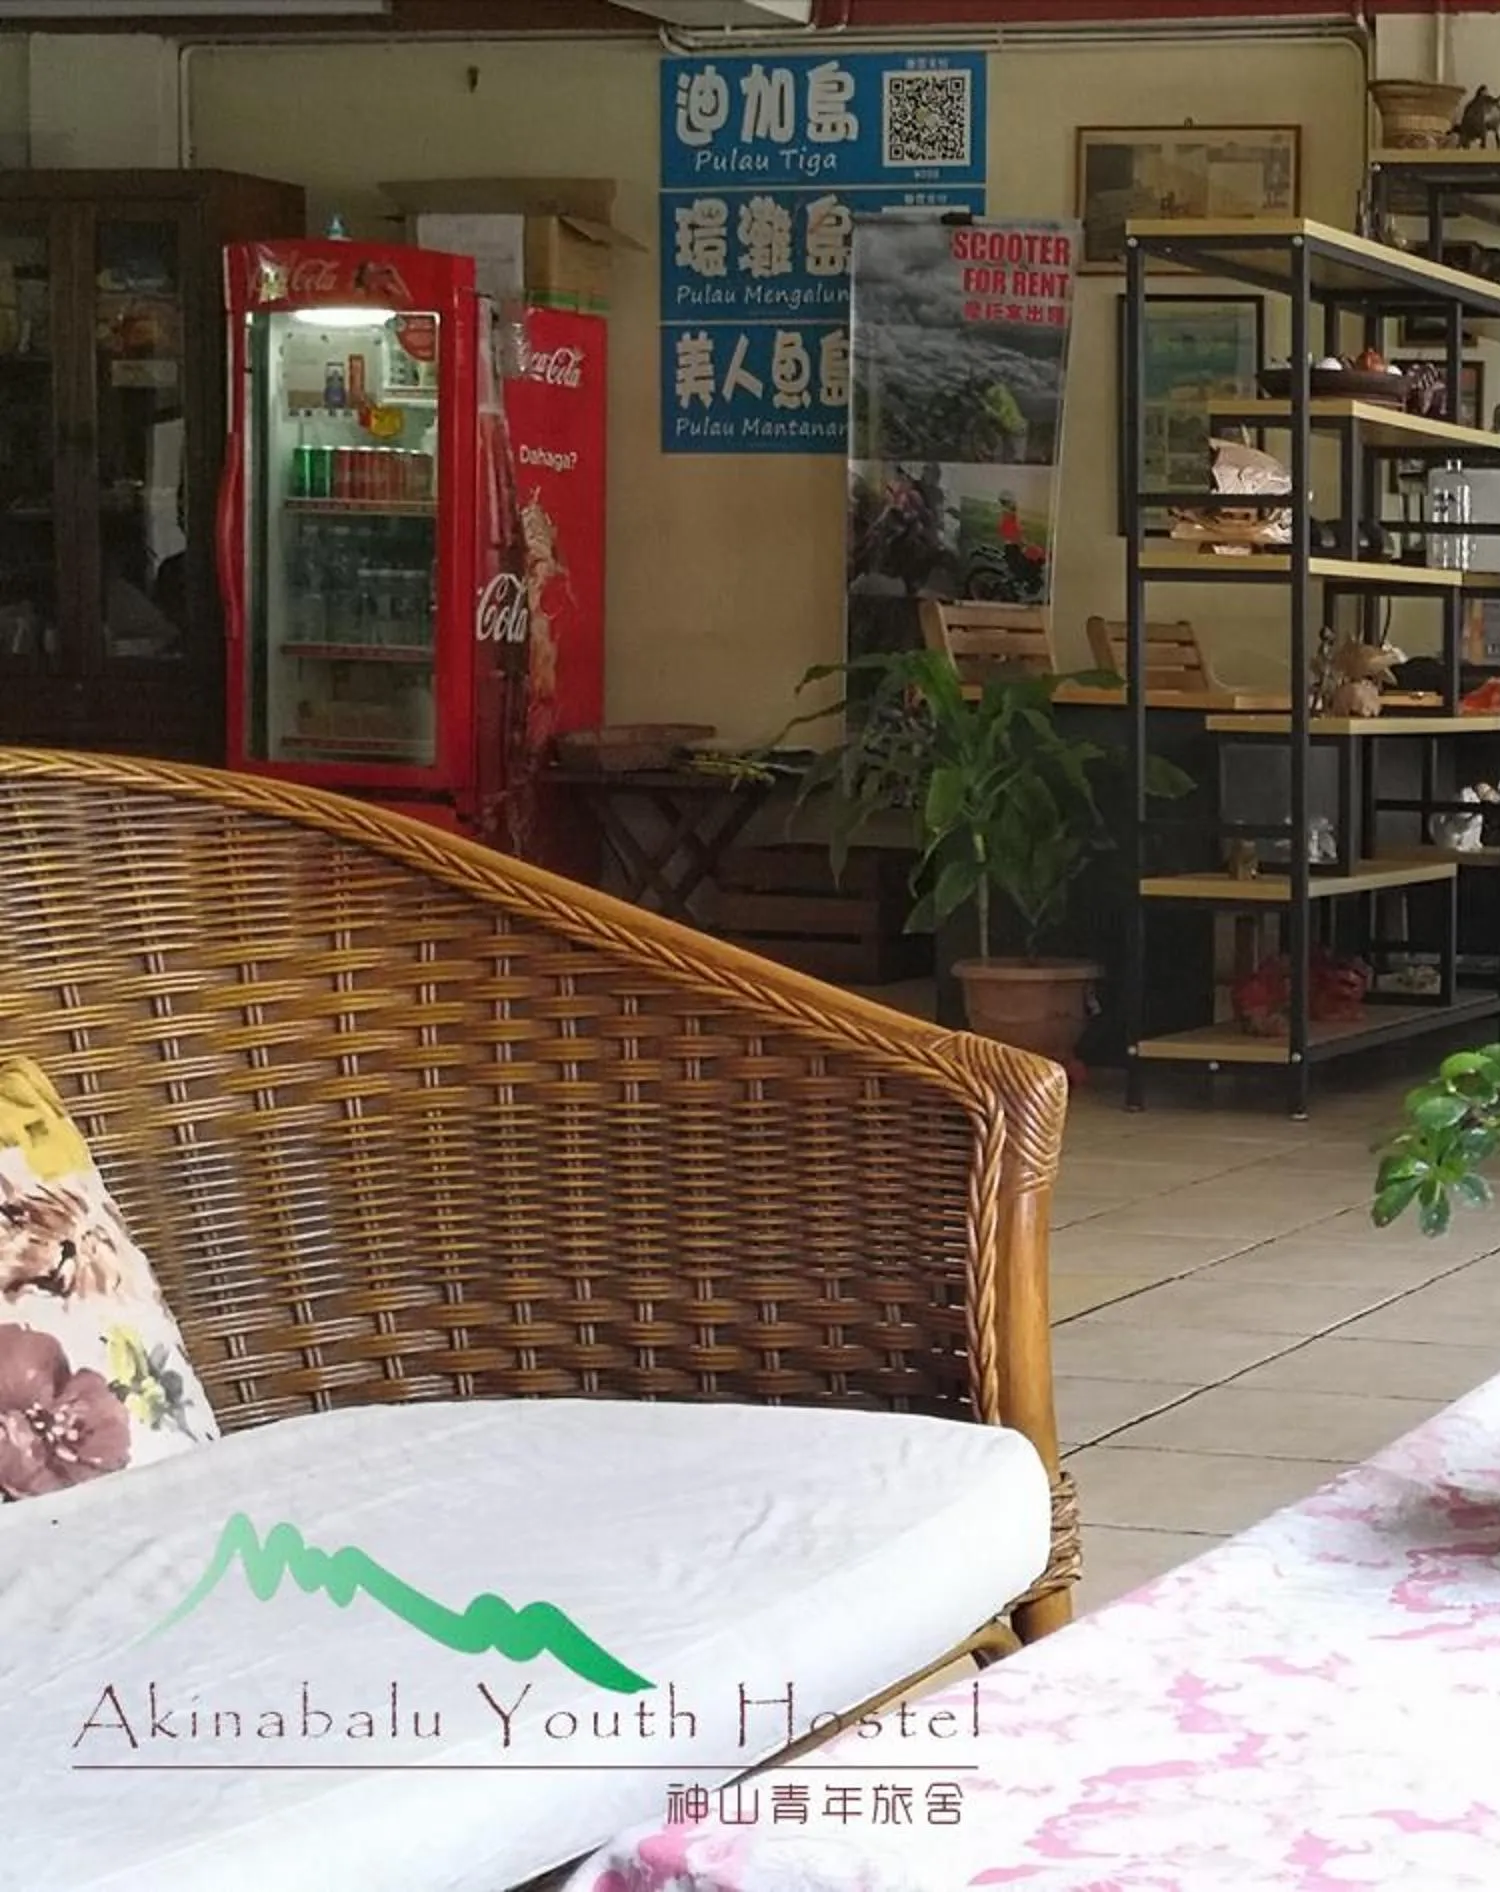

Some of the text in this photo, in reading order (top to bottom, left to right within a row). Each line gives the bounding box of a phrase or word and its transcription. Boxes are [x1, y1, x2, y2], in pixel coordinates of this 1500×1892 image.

[695, 147, 838, 177] Pulau Tiga
[953, 231, 1071, 265] SCOOTER
[677, 284, 736, 305] Pulau
[963, 267, 1069, 299] FOR RENT
[675, 416, 735, 436] Pulau
[519, 444, 578, 472] Dahaga?
